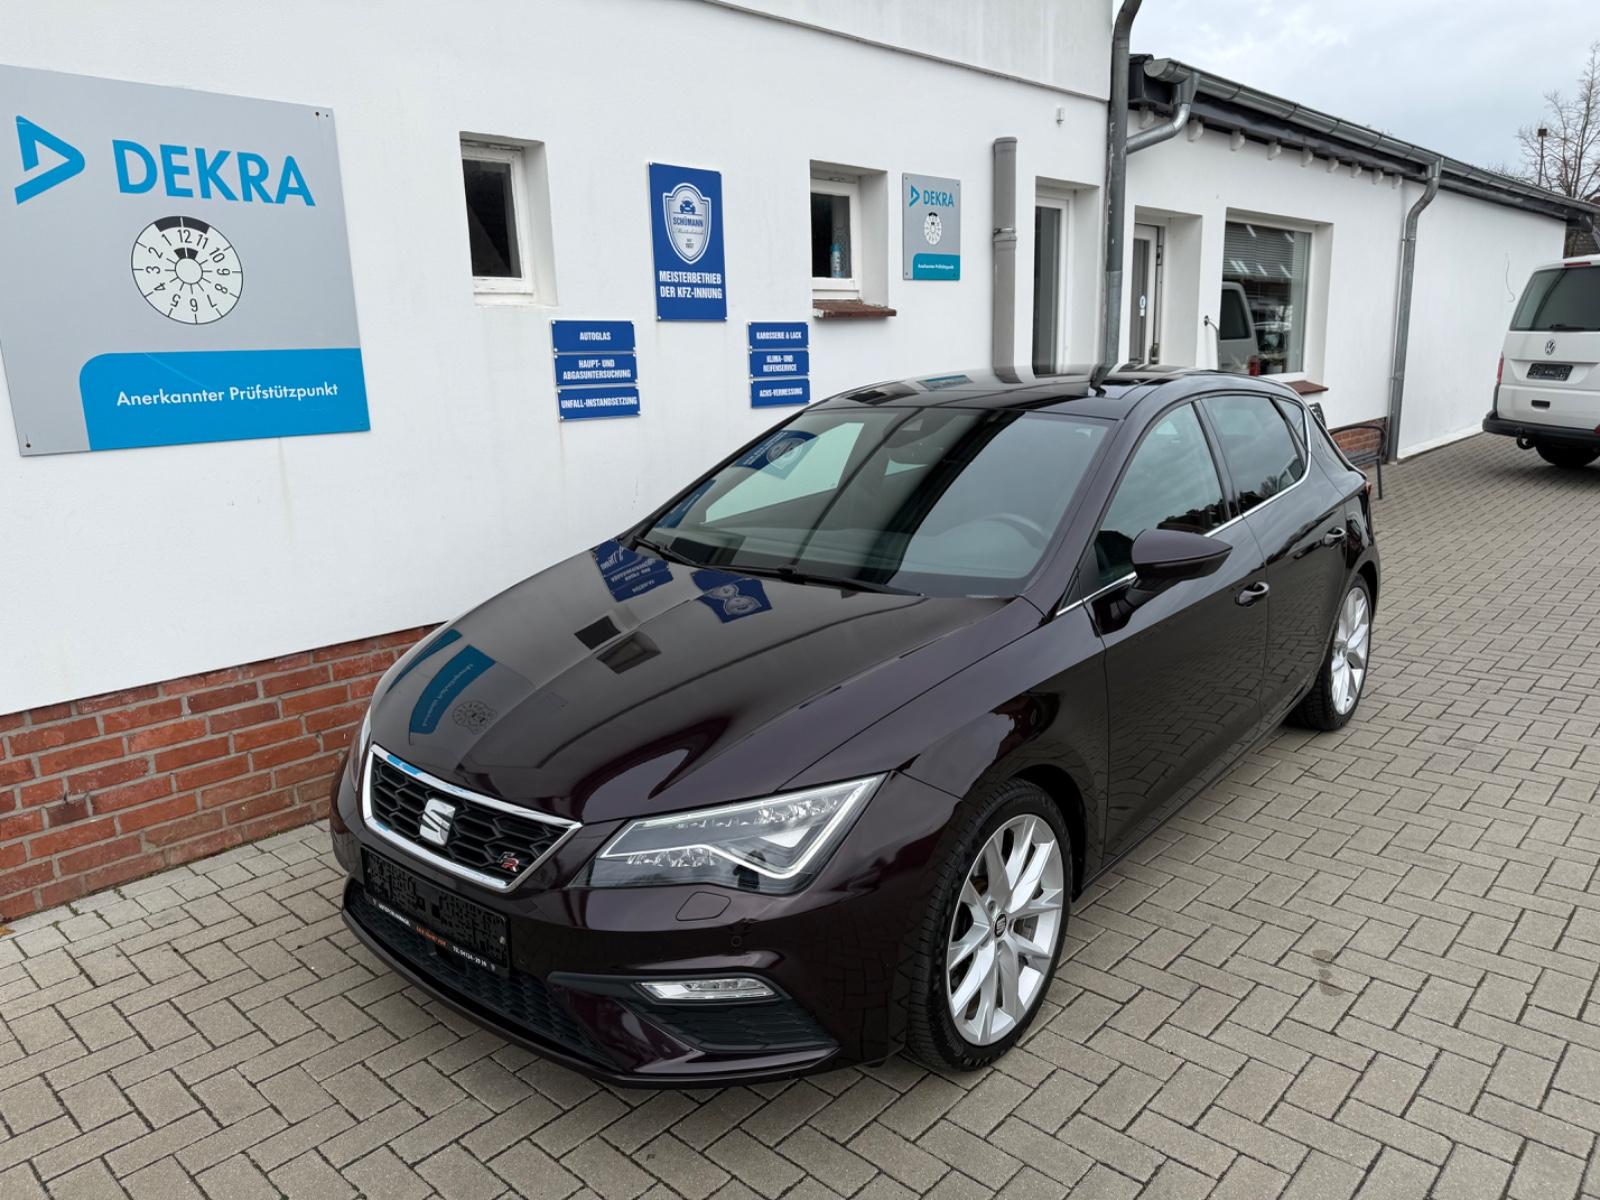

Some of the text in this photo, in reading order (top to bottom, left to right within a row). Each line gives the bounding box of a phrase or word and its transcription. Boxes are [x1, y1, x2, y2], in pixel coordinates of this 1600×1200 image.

[112, 139, 316, 206] DEKRA
[923, 189, 955, 208] DEKRA
[672, 215, 704, 227] SCHÜMANN
[161, 234, 172, 246] 1
[177, 229, 192, 243] 12
[197, 234, 209, 249] 11
[148, 246, 163, 259] 2
[209, 247, 225, 263] 10
[145, 266, 161, 274] 3
[216, 268, 230, 276] 9
[659, 270, 722, 284] MEISTERBETRIEB
[153, 282, 166, 291] 4
[214, 283, 228, 294] 8
[660, 286, 723, 299] DER KFZ-INNUNG
[170, 294, 181, 307] 5
[189, 298, 198, 312] 6
[207, 294, 217, 308] 7
[579, 331, 612, 341] AUTOGLAS
[790, 331, 802, 339] LACK
[578, 359, 615, 368] HAUPT- UND
[563, 369, 632, 380] ABGASUNTERSUCHUNG
[117, 381, 338, 406] Anerkannter Prüfstützpunkt
[560, 396, 638, 409] UNFALL-INSTANDSETZUNG
